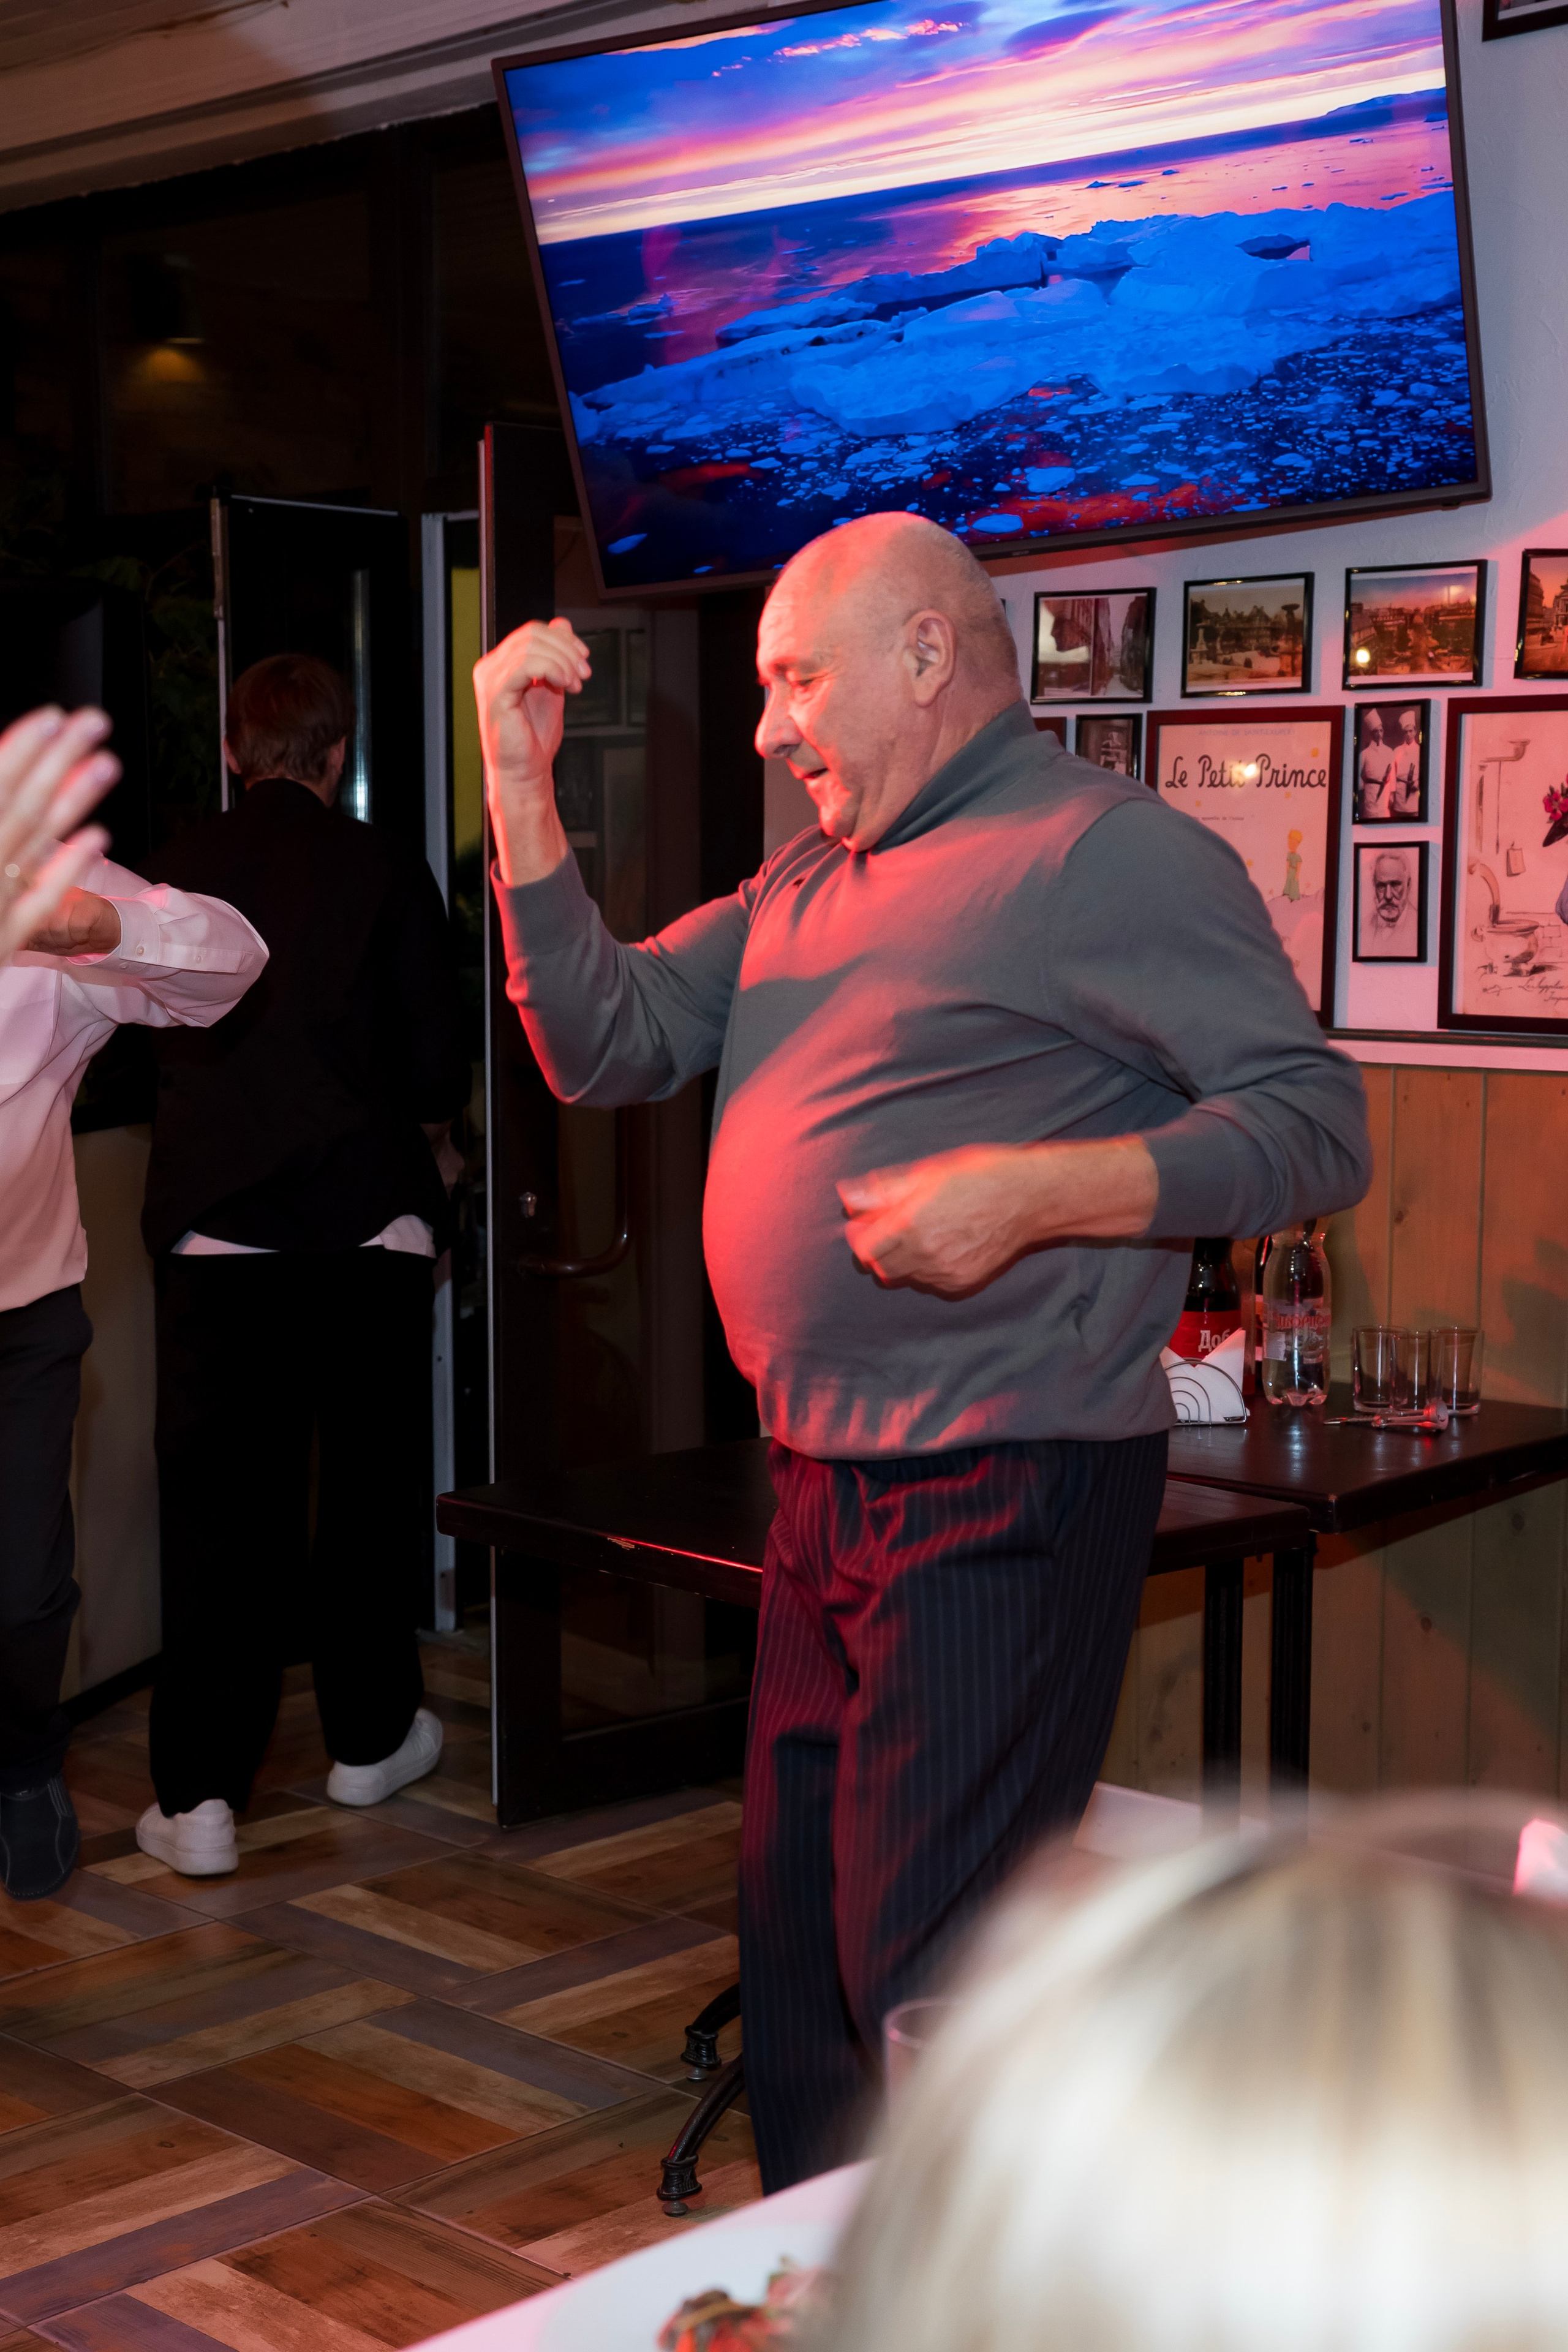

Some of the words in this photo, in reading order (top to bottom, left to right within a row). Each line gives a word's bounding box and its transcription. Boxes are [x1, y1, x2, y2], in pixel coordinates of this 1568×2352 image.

[1165, 756, 1188, 789] Le
[1198, 755, 1245, 788] Petit
[1256, 753, 1327, 788] Prince
